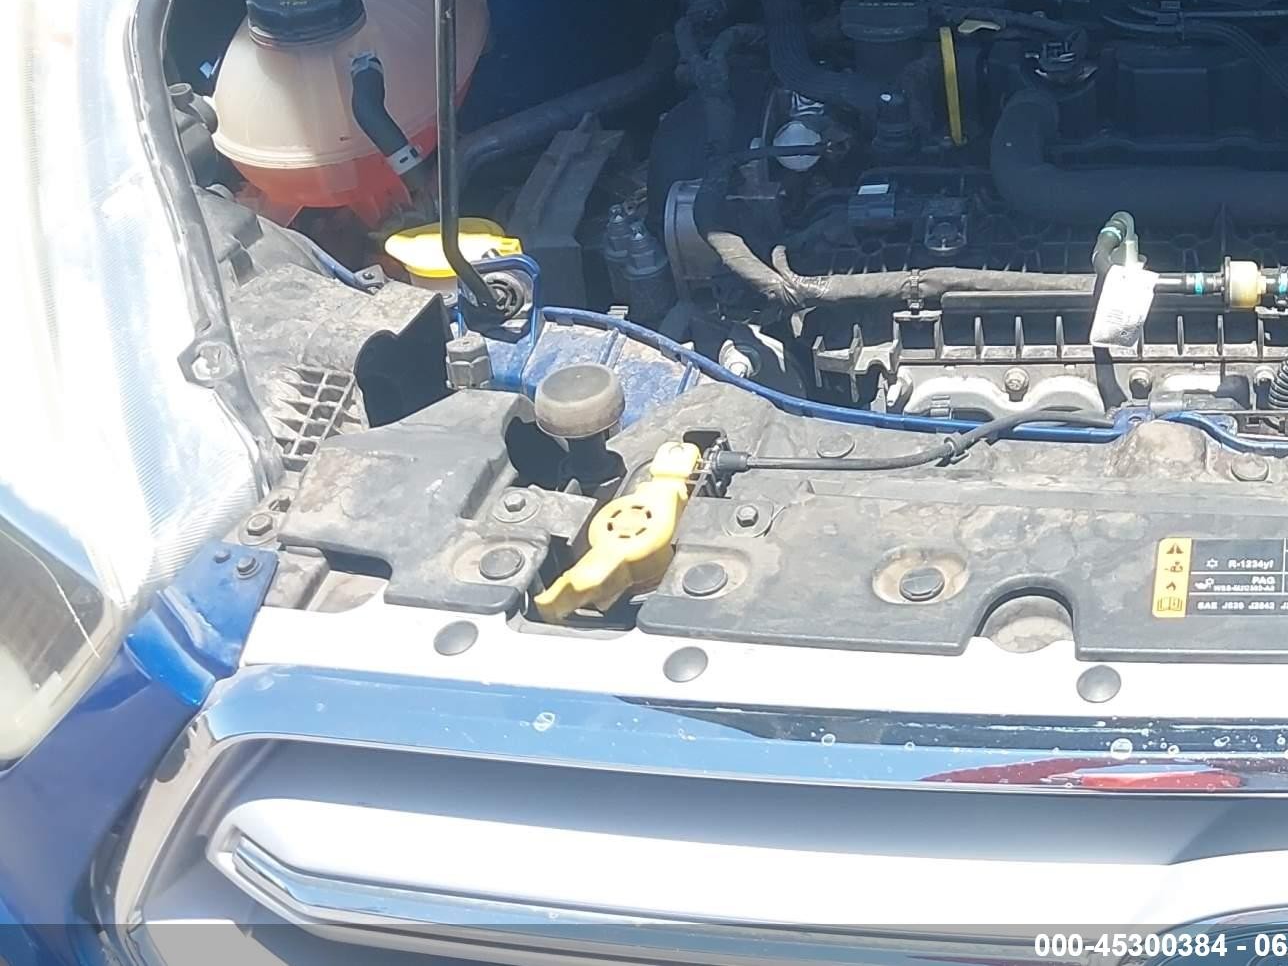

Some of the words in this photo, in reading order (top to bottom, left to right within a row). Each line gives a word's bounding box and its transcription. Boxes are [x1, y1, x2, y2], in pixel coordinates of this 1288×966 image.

[1228, 559, 1274, 570] R-1234yf
[1252, 576, 1275, 585] PAG
[1197, 601, 1218, 610] SAE
